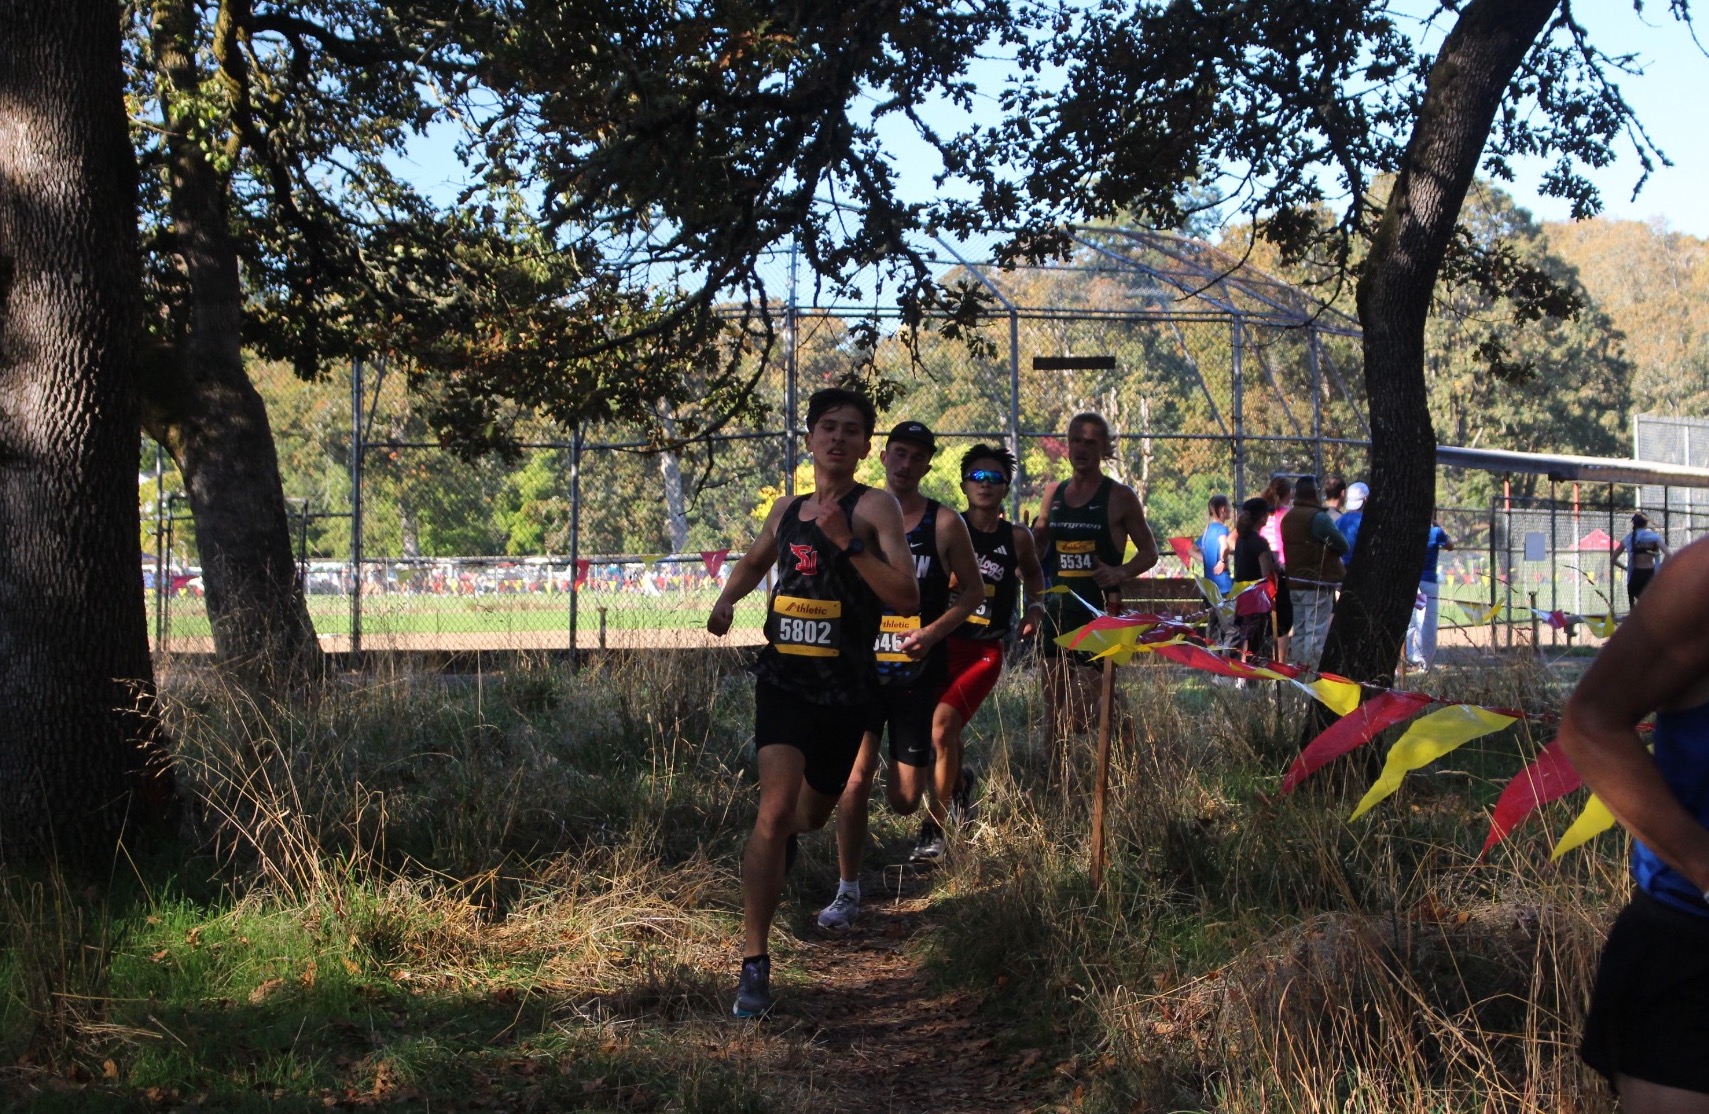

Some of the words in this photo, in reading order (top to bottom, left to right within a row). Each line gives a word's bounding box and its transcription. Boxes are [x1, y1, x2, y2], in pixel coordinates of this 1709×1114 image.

[1060, 554, 1092, 569] 5534
[785, 601, 828, 615] Athletic
[779, 617, 832, 644] 5802
[882, 619, 911, 629] thletic
